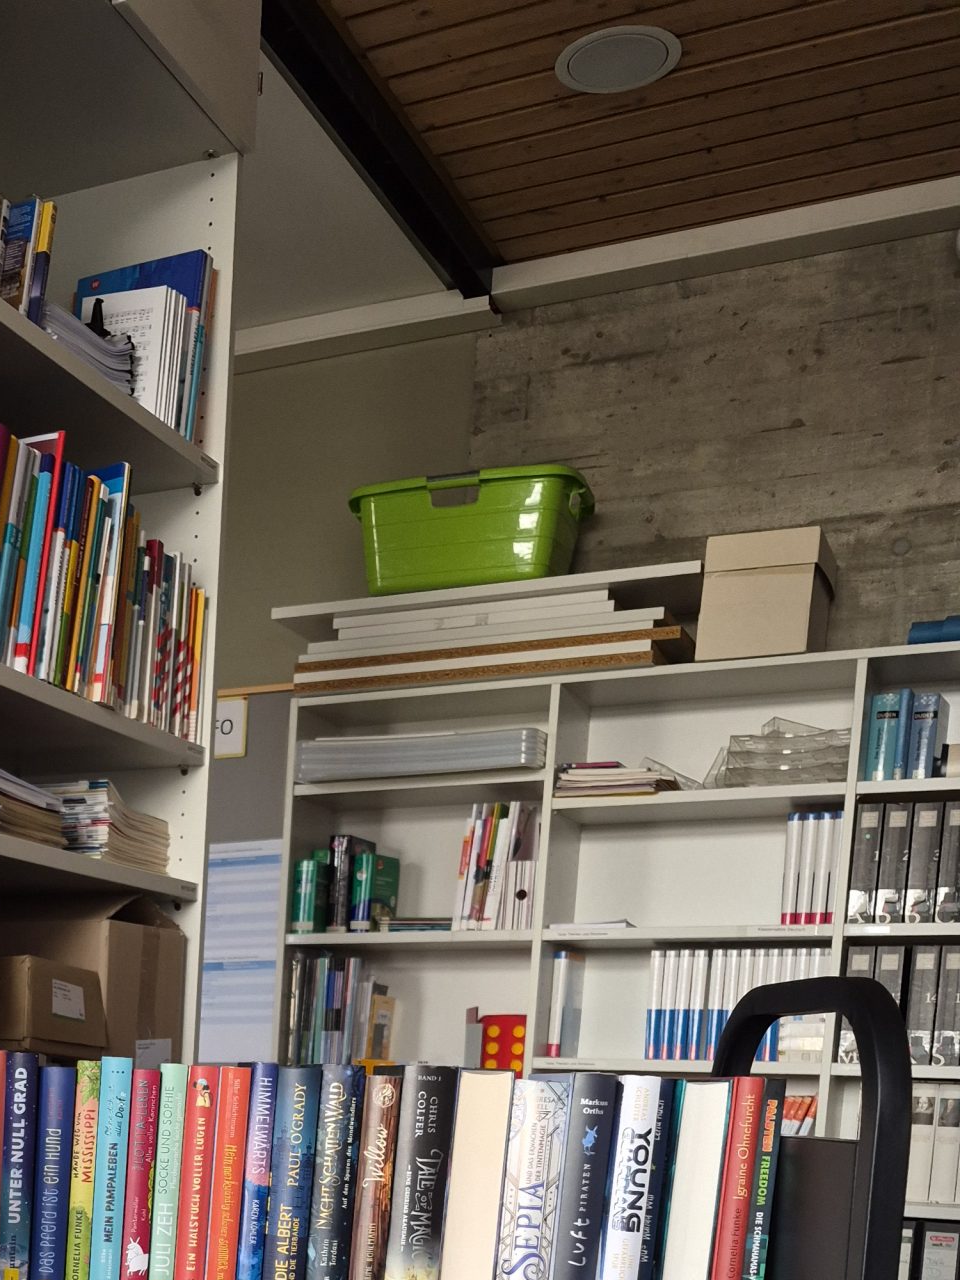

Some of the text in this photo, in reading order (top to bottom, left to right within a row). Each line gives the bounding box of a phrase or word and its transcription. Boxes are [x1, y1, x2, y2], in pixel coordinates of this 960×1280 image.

[253, 1077, 273, 1175] HIMMELWÄRTS
[414, 1091, 427, 1138] COLFER
[428, 1096, 438, 1134] CHRIS
[580, 1097, 609, 1107] Markus
[582, 1106, 604, 1116] Orths
[7, 1066, 28, 1225] UNTER NULL GRAD
[158, 1085, 175, 1195] SOCKE UND SOPHIE
[286, 1082, 307, 1187] PAUL O'GRADY
[362, 1126, 388, 1190] Willow
[732, 1093, 755, 1201] Igraine Ohnefurcht
[43, 1161, 59, 1185] ein
[44, 1187, 59, 1207] ist
[105, 1141, 119, 1212] PAMPALEBEN
[624, 1127, 653, 1234] YOUNG
[756, 1155, 771, 1206] FREEDOM
[40, 1209, 57, 1247] Pferd
[74, 1209, 83, 1240] FUNKE
[103, 1213, 113, 1244] MEIN
[153, 1202, 174, 1276] JULI ZEH
[276, 1203, 293, 1255] ALBERT
[567, 1163, 592, 1267] Luft PIRATEN
[320, 1239, 328, 1267] Kathrin
[330, 1239, 338, 1266] Tordasi
[726, 1207, 742, 1279] Cornelia Funke
